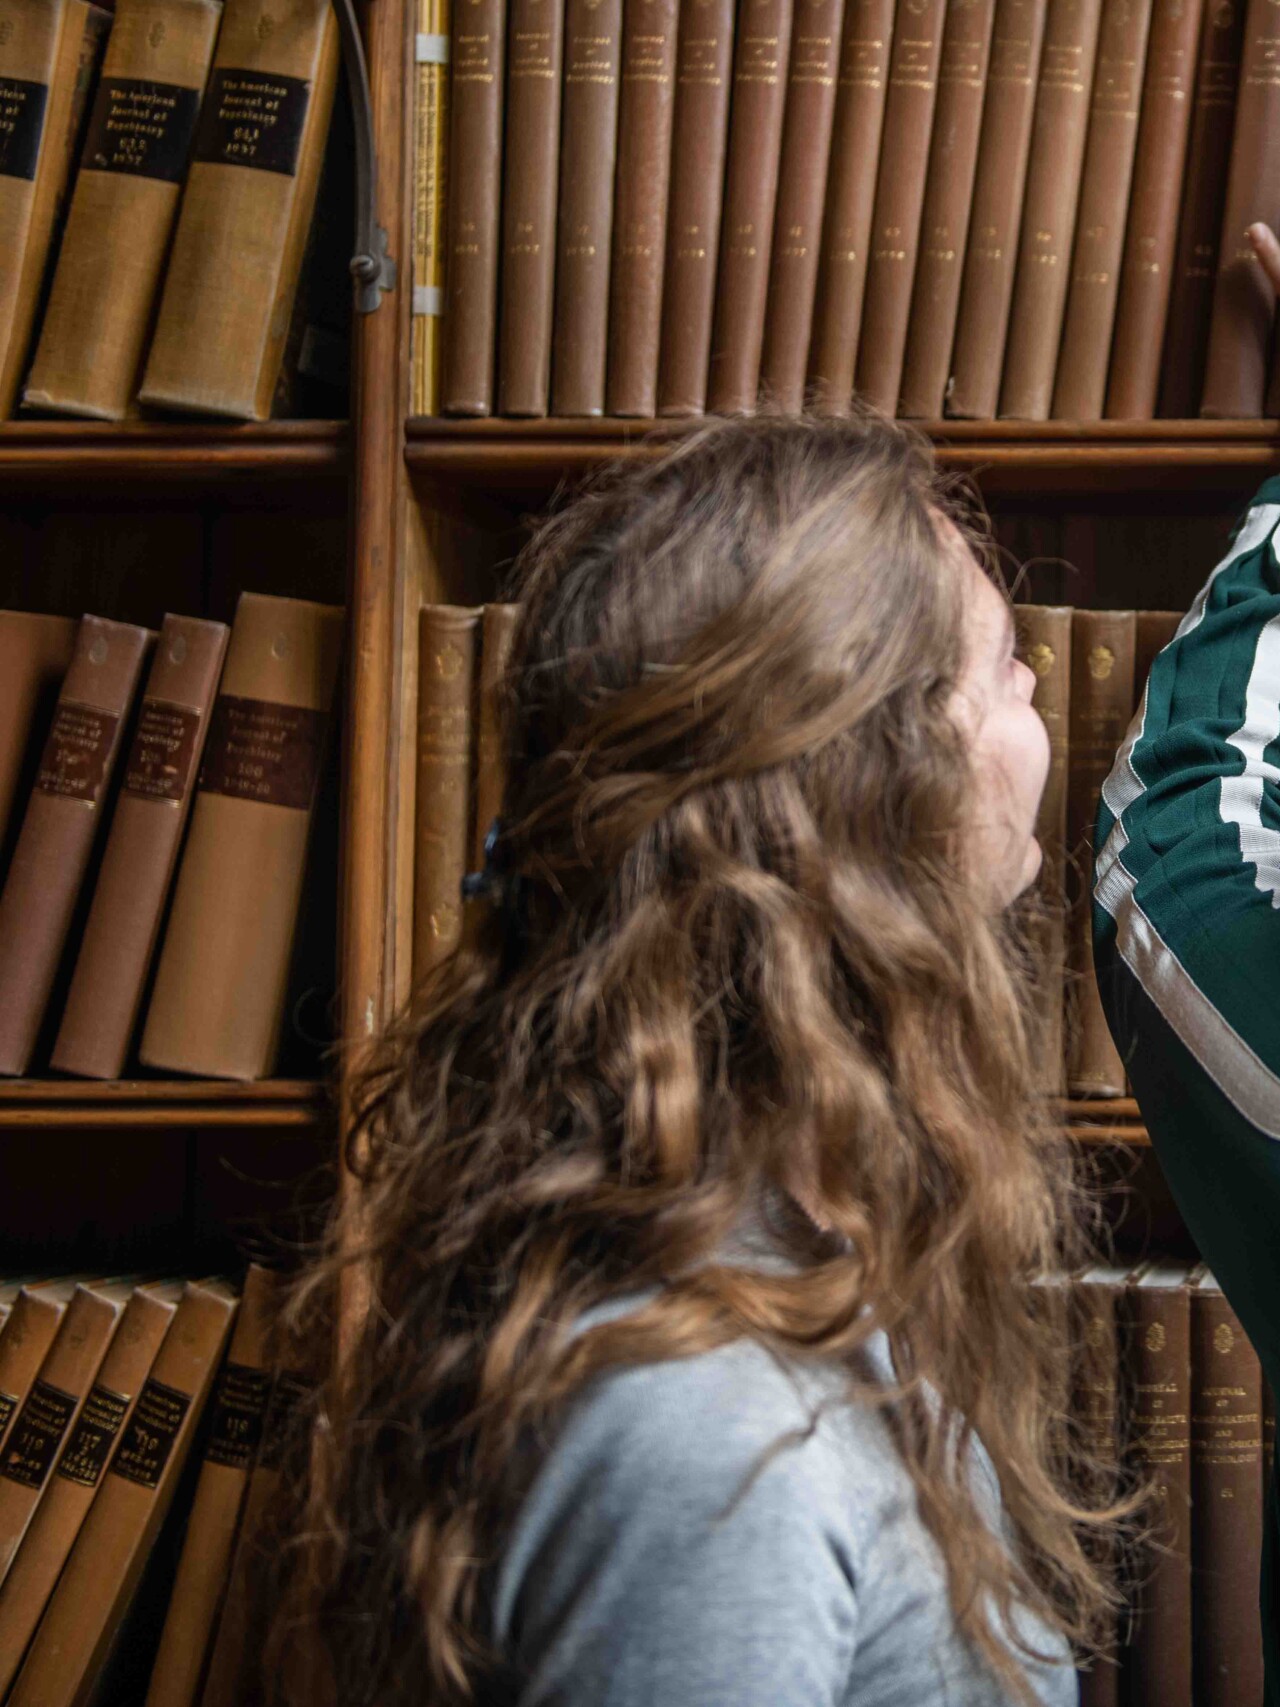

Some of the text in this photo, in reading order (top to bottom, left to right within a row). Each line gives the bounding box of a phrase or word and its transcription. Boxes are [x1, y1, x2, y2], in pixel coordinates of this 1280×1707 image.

[241, 81, 288, 97] American
[130, 91, 176, 108] American
[223, 94, 280, 112] Journal of
[111, 105, 169, 122] Journal of
[219, 108, 279, 126] Psychiatry
[107, 120, 165, 139] Psychiatry
